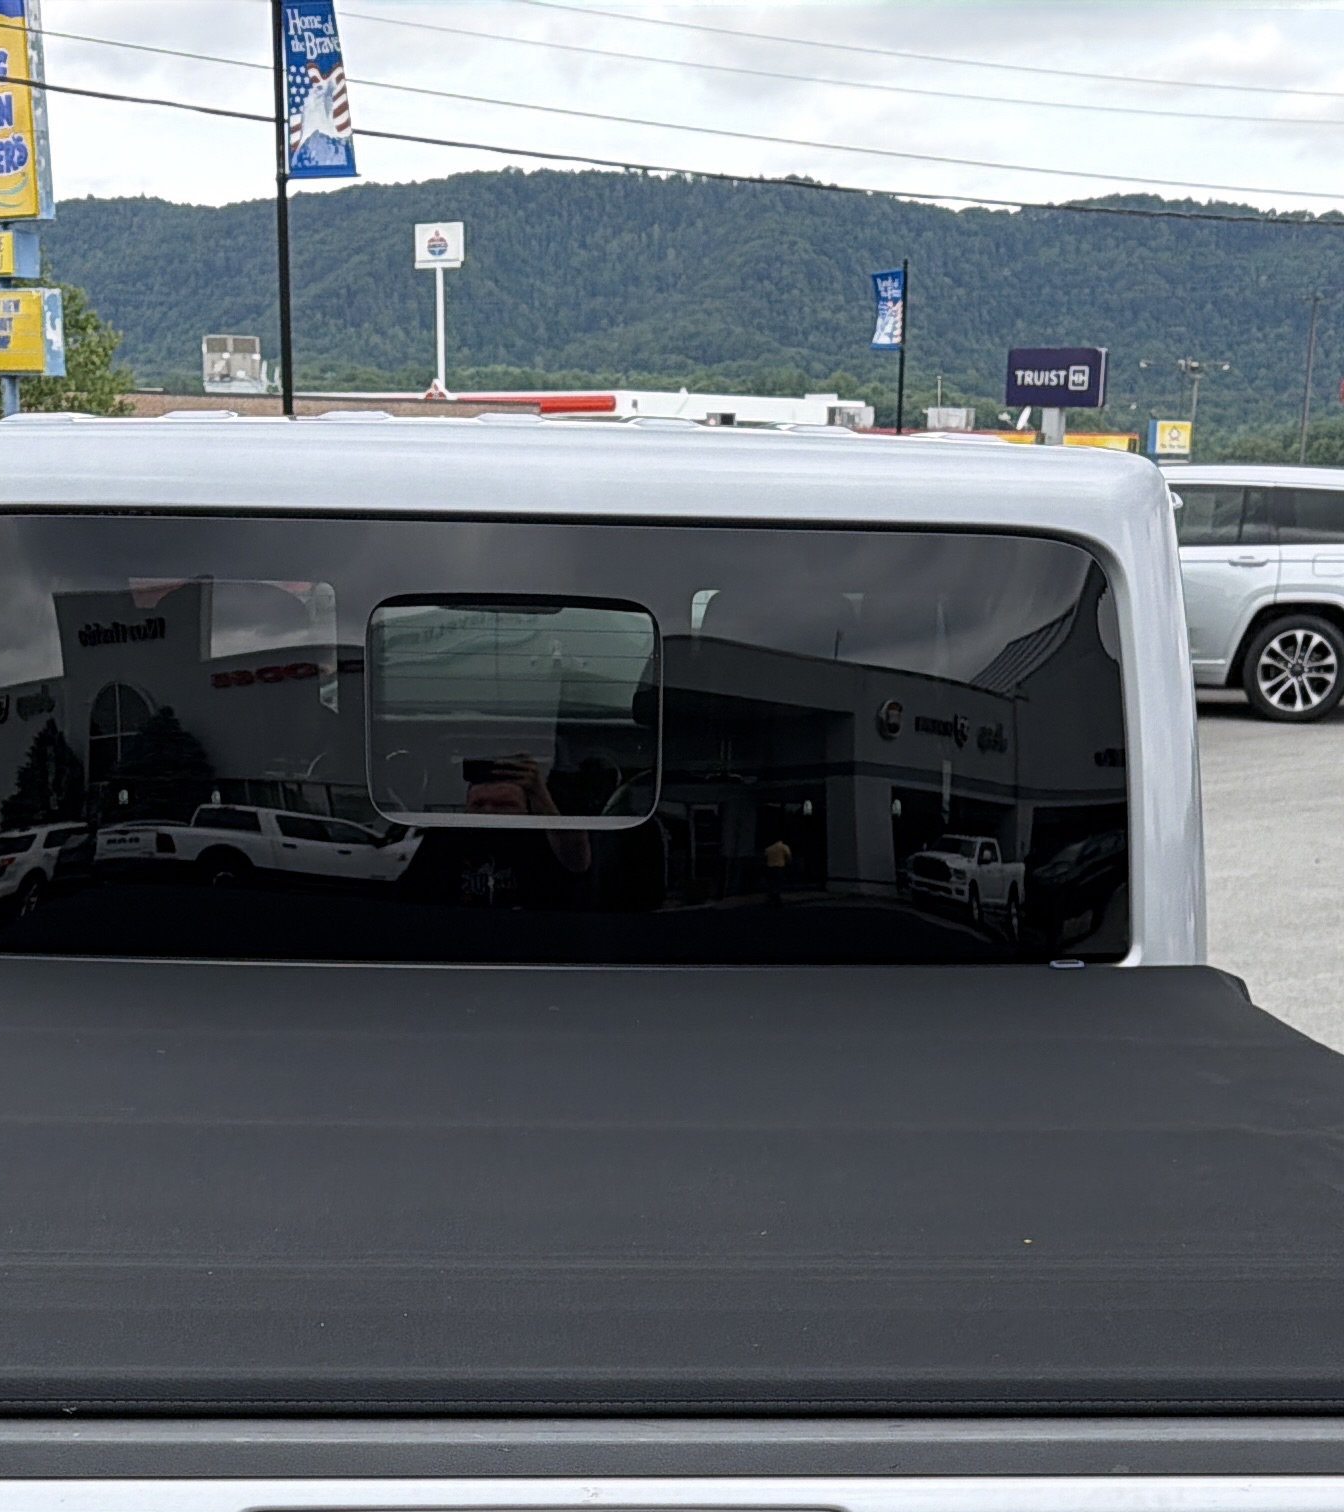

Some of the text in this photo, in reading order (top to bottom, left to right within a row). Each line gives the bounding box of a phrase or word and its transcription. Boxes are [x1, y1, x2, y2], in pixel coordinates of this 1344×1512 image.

[286, 9, 334, 35] Home of
[291, 32, 341, 59] the Brave
[1014, 370, 1067, 386] TRUIST
